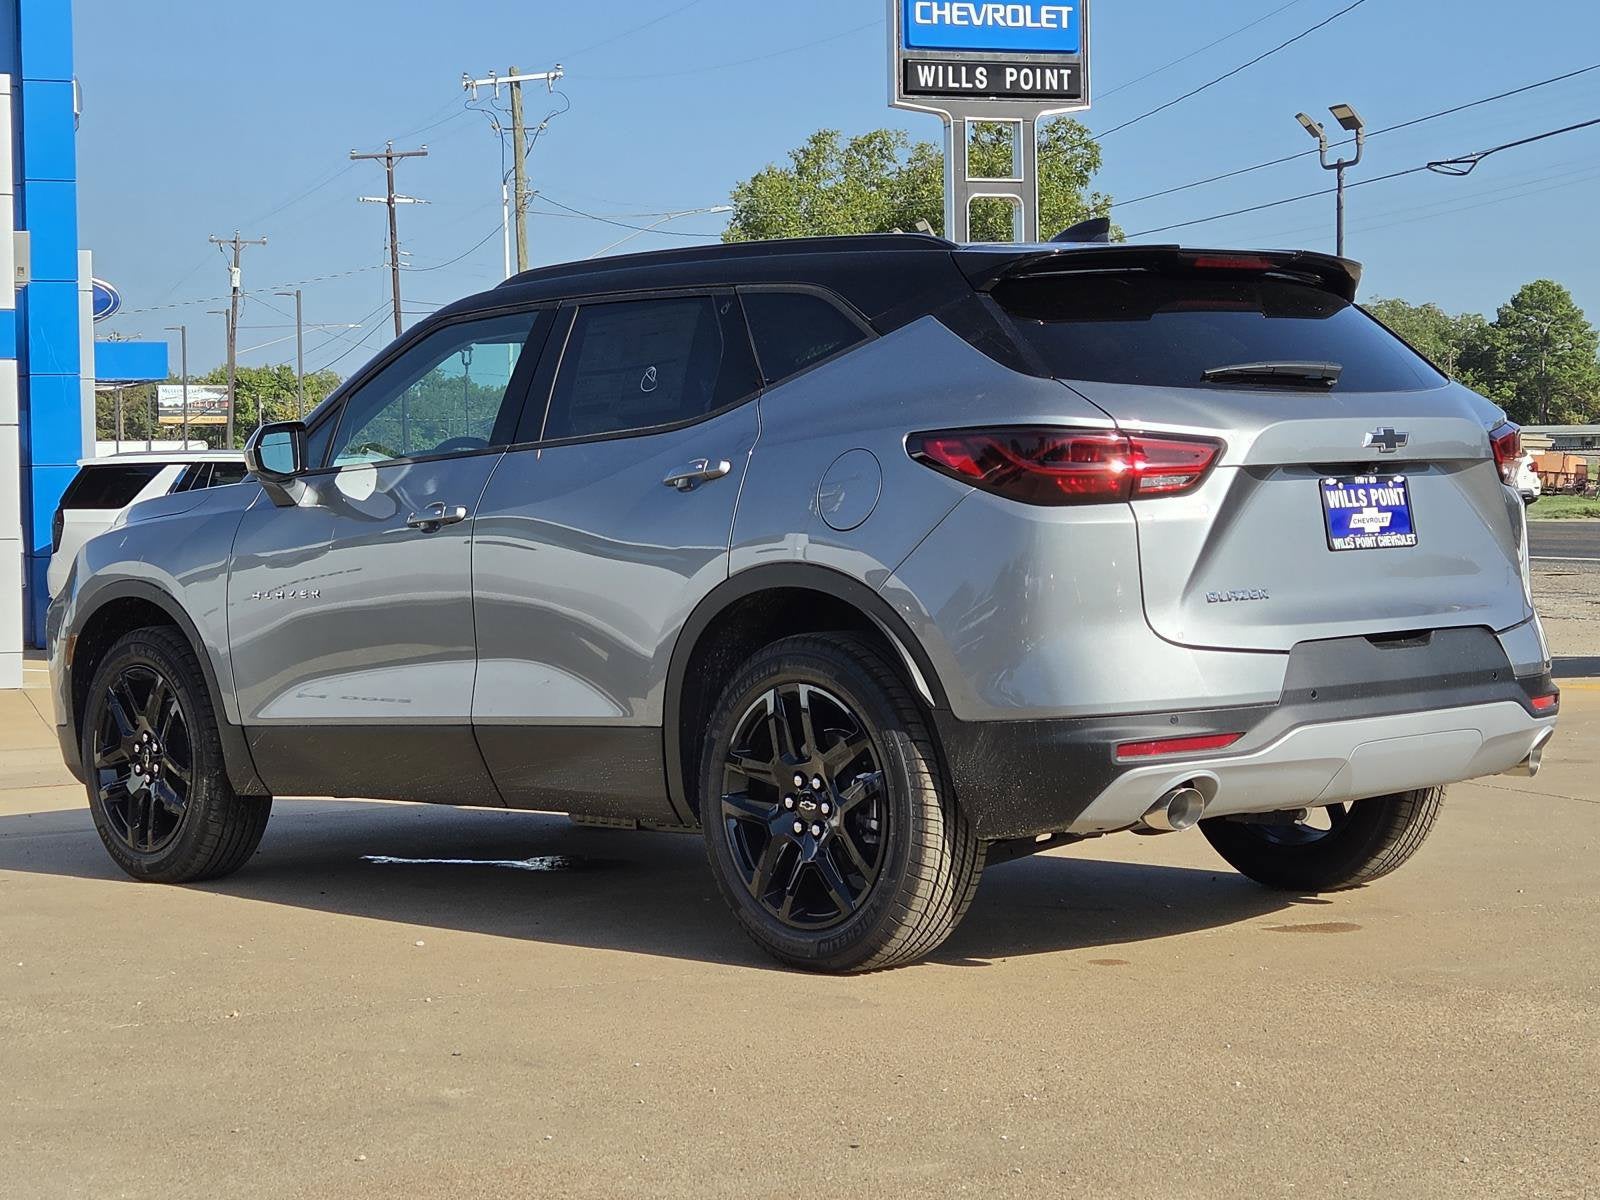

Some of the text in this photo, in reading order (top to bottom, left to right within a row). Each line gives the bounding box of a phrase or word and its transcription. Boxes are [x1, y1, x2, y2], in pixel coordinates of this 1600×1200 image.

[914, 1, 1073, 29] CHEVROLET
[917, 65, 1072, 91] WILLS POINT
[1325, 487, 1405, 509] WILLS POINT
[1352, 516, 1389, 525] CHEVROLET
[1332, 537, 1355, 550] WILLS
[1355, 536, 1377, 549] POINT
[1377, 533, 1417, 547] CHEVROLET
